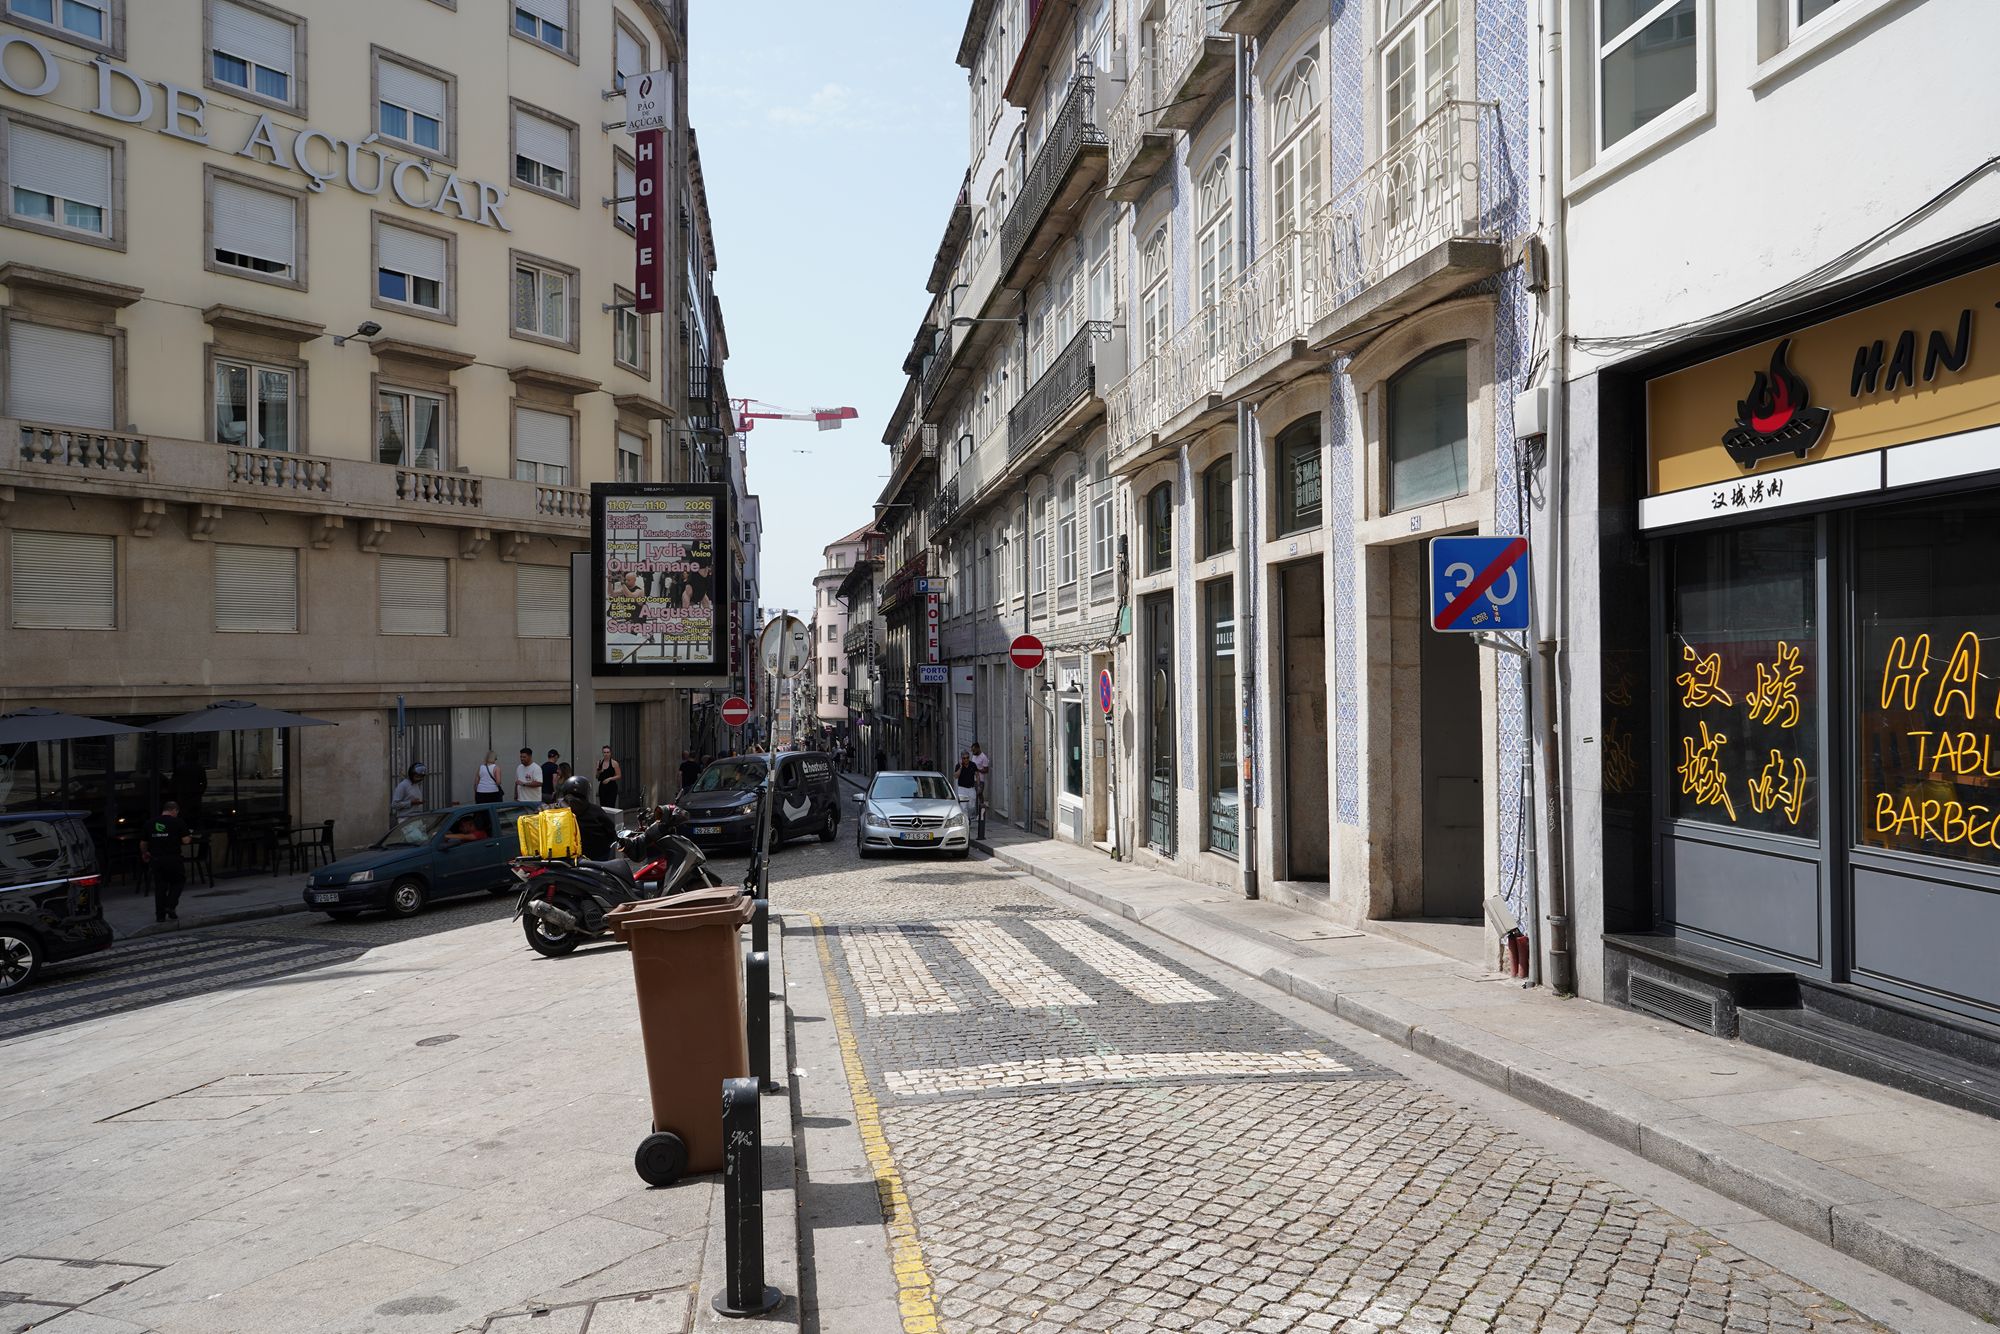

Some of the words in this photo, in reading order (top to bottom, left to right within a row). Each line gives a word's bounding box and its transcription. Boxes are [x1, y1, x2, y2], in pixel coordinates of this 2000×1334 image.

[637, 101, 655, 111] PÃO
[629, 115, 664, 129] AÇÚCAR
[90, 57, 210, 146] DE
[235, 113, 512, 232] AÇÚCAR
[638, 142, 654, 301] HOTEL
[1850, 309, 1974, 399] HAN
[1296, 459, 1321, 485] SMA
[1712, 478, 1783, 510] 汉城烤肉
[685, 500, 711, 510] 2026
[607, 514, 648, 523] Exposições
[685, 522, 711, 530] Galeria
[644, 530, 680, 538] Municipal
[607, 543, 626, 551] Para
[646, 543, 686, 560] Lydia
[607, 558, 700, 572] Ourahmane
[919, 579, 927, 591] P
[1444, 562, 1518, 606] 30
[639, 604, 711, 621] Augustas
[607, 620, 683, 637] Serapinas
[928, 595, 938, 663] HOTEL
[1881, 631, 2000, 719] HA
